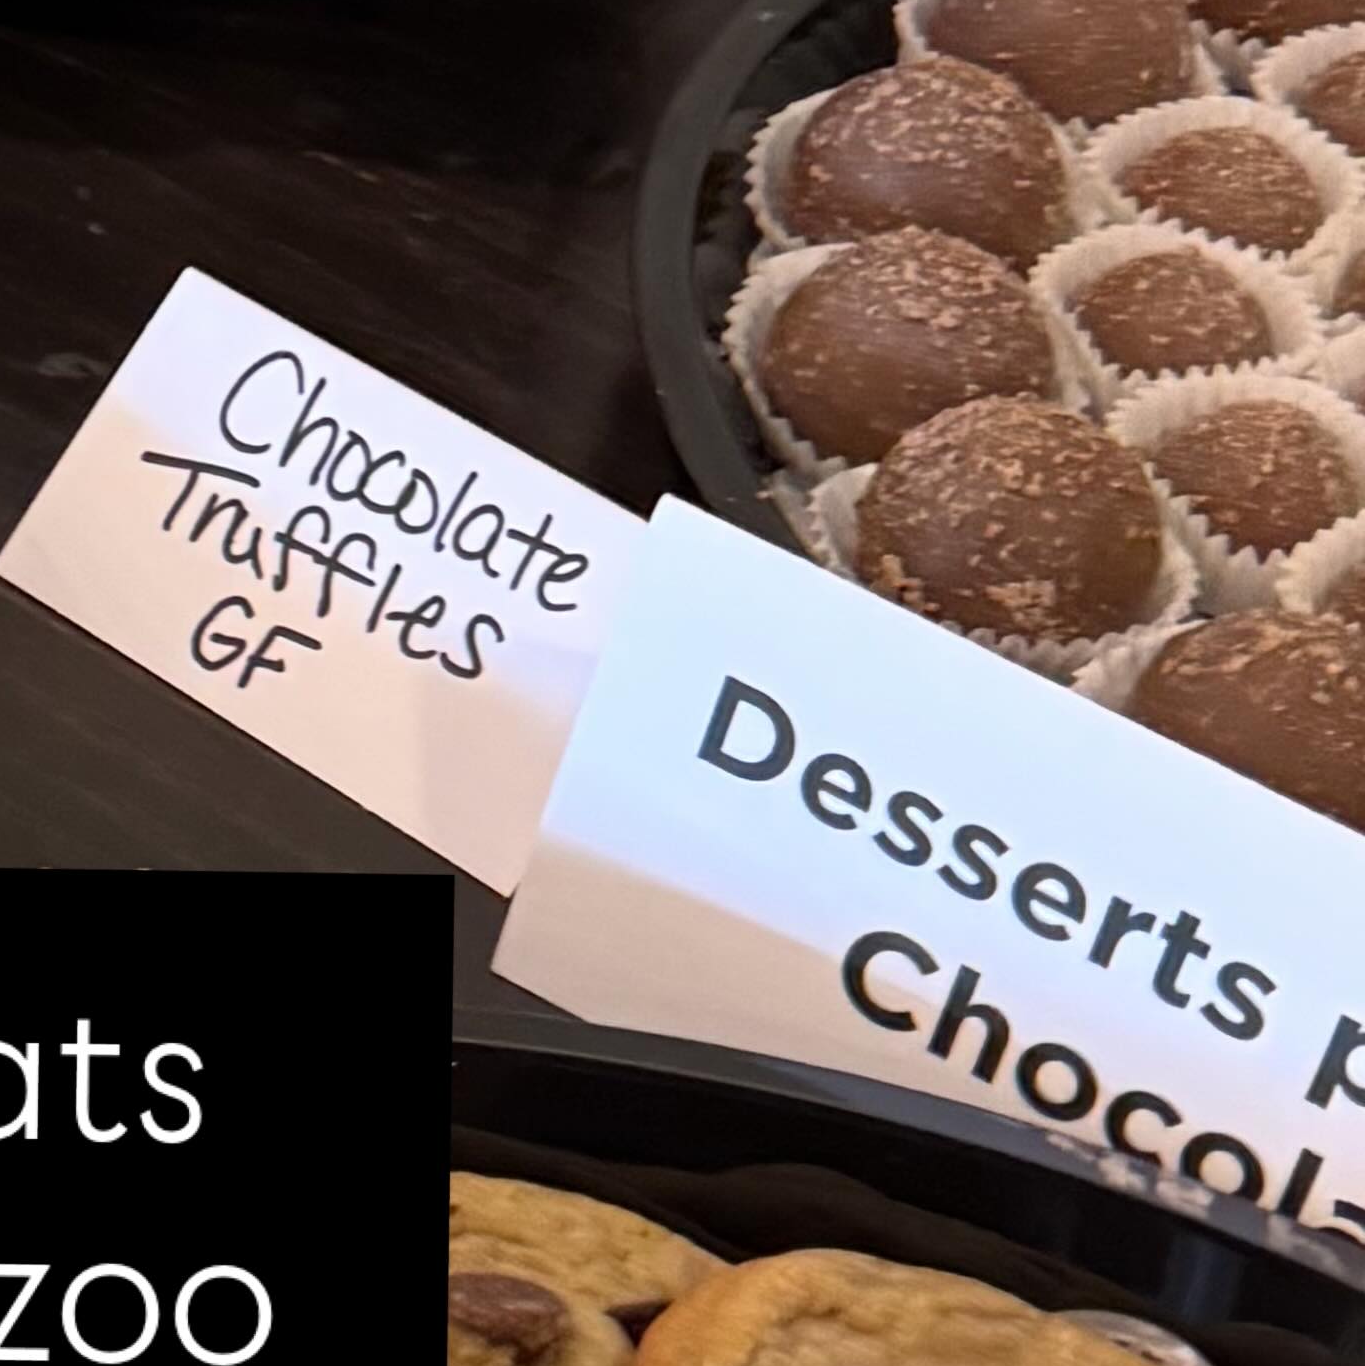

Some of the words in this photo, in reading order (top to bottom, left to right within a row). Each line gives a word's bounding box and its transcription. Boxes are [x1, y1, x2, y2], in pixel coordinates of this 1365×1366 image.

[140, 449, 506, 681] Truffles
[218, 349, 590, 613] Chocolate
[190, 595, 324, 689] GF
[697, 674, 1277, 1042] Desserts
